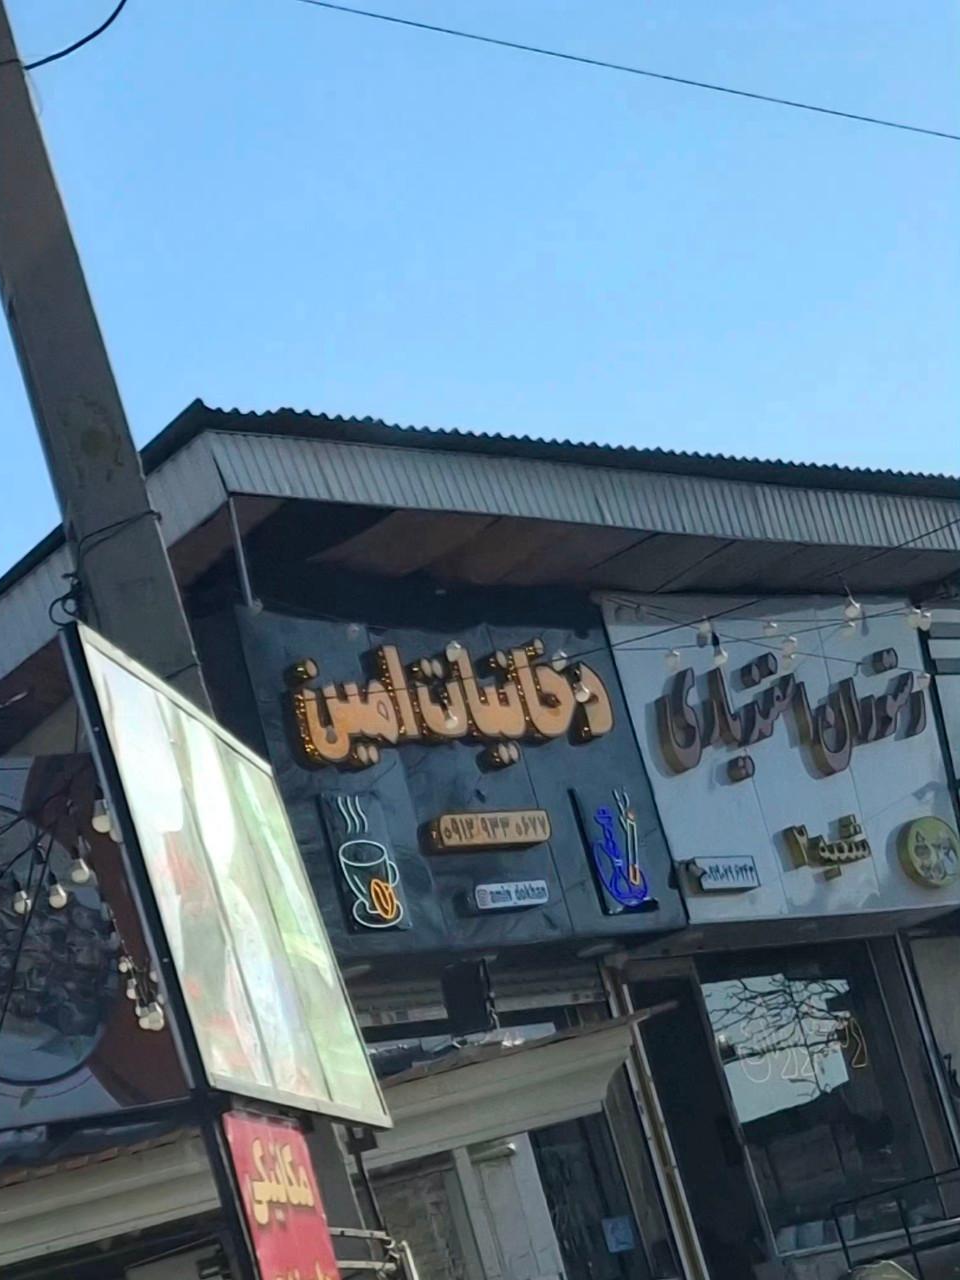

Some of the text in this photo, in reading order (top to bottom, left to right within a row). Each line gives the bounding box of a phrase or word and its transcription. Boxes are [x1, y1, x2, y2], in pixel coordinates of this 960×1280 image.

[295, 638, 615, 766] دخانیات امین
[798, 646, 928, 780] رستوران
[808, 813, 873, 880] شعبه
[251, 1137, 315, 1225] مکانیکی
